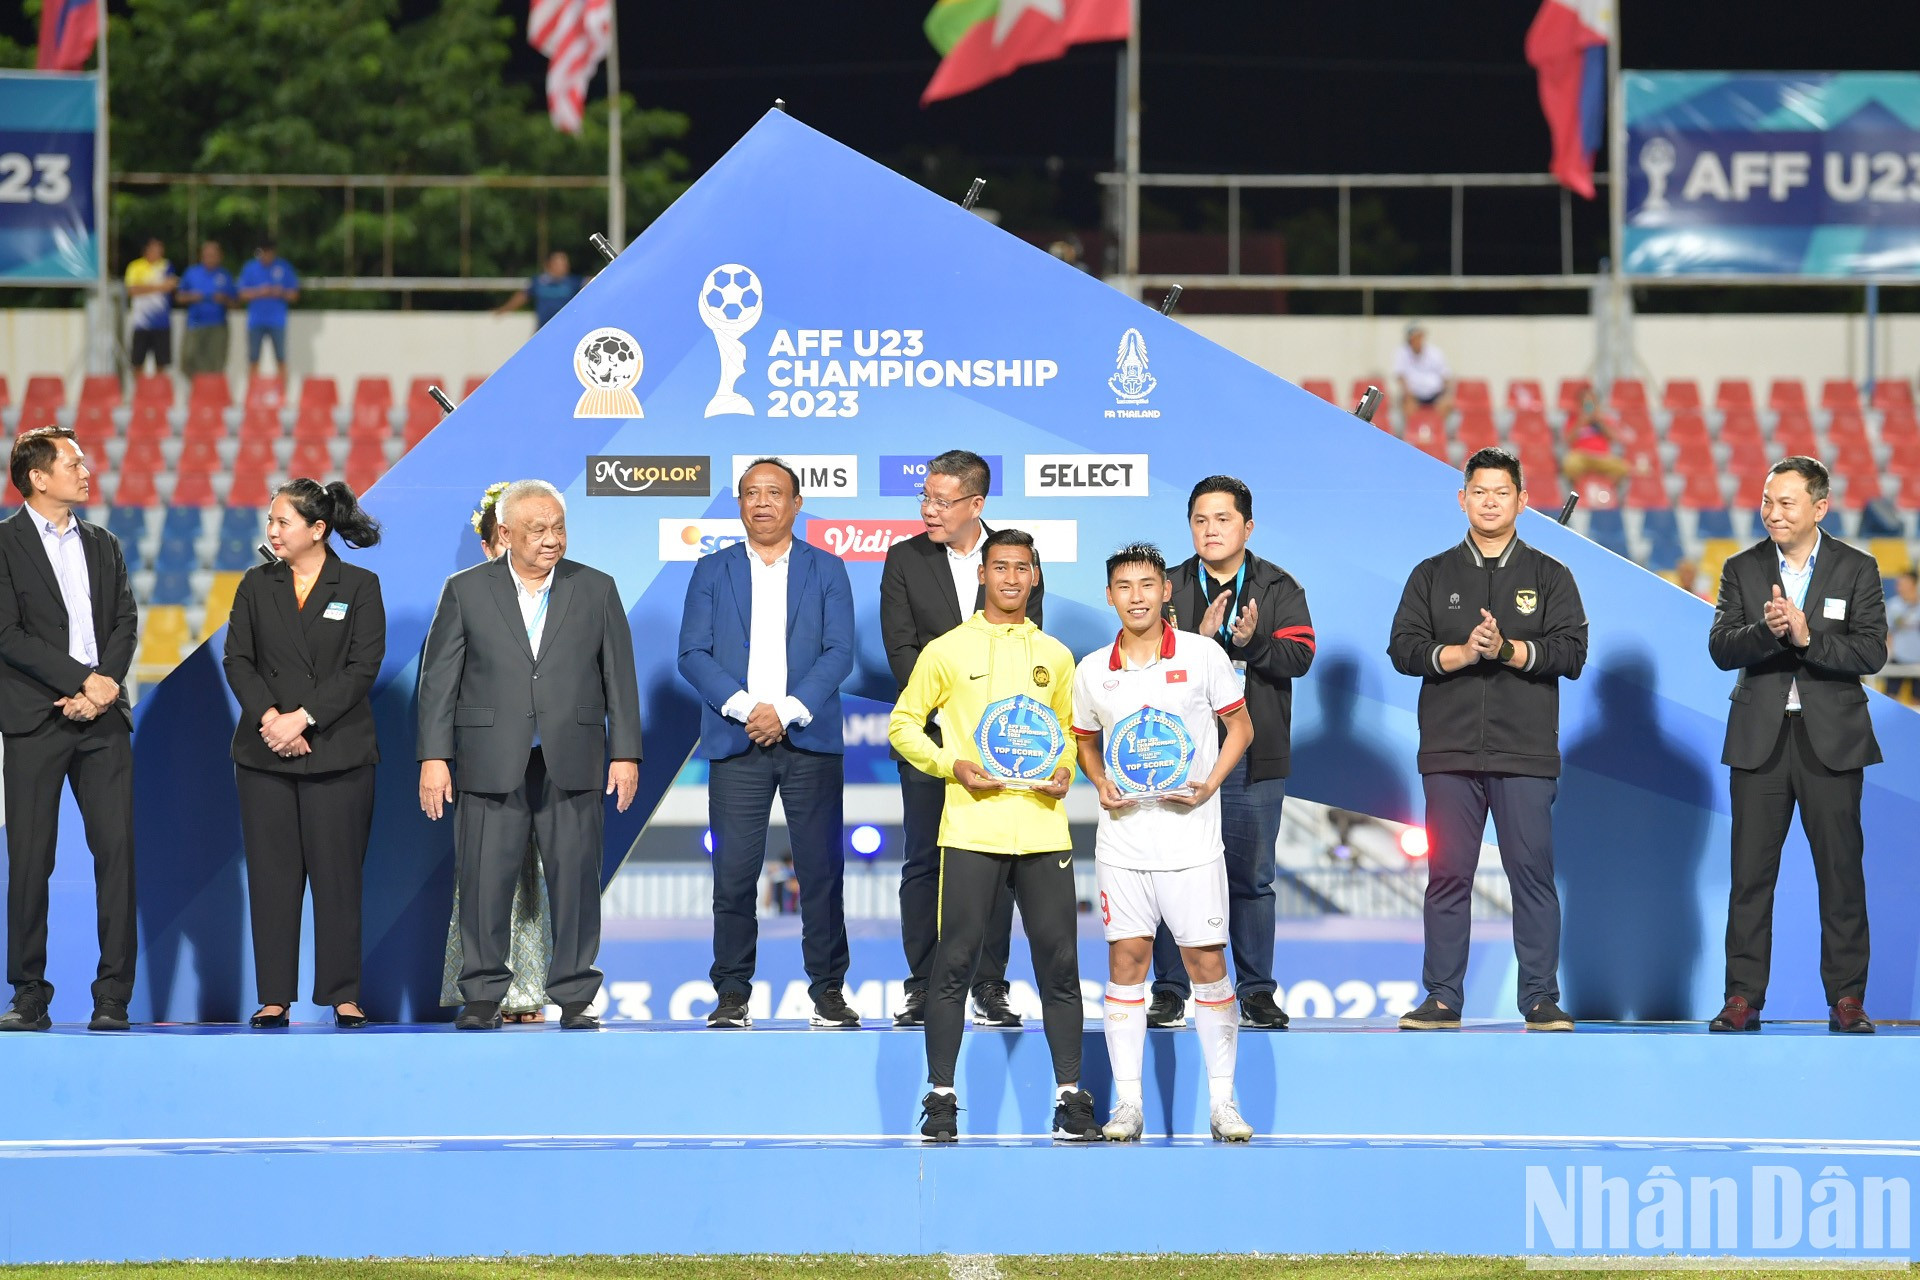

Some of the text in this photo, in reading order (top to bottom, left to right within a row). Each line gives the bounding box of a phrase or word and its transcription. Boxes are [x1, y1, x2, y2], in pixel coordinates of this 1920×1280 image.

[1682, 151, 1811, 201] AFF
[767, 329, 924, 357] AFF U23
[767, 359, 1058, 387] CHAMPIONSHIP
[767, 390, 859, 418] 2023
[1117, 410, 1161, 418] THAILAND
[1040, 464, 1133, 487] SELECT
[994, 746, 1044, 757] TOP SCORER
[1126, 760, 1175, 771] TOP SCORER
